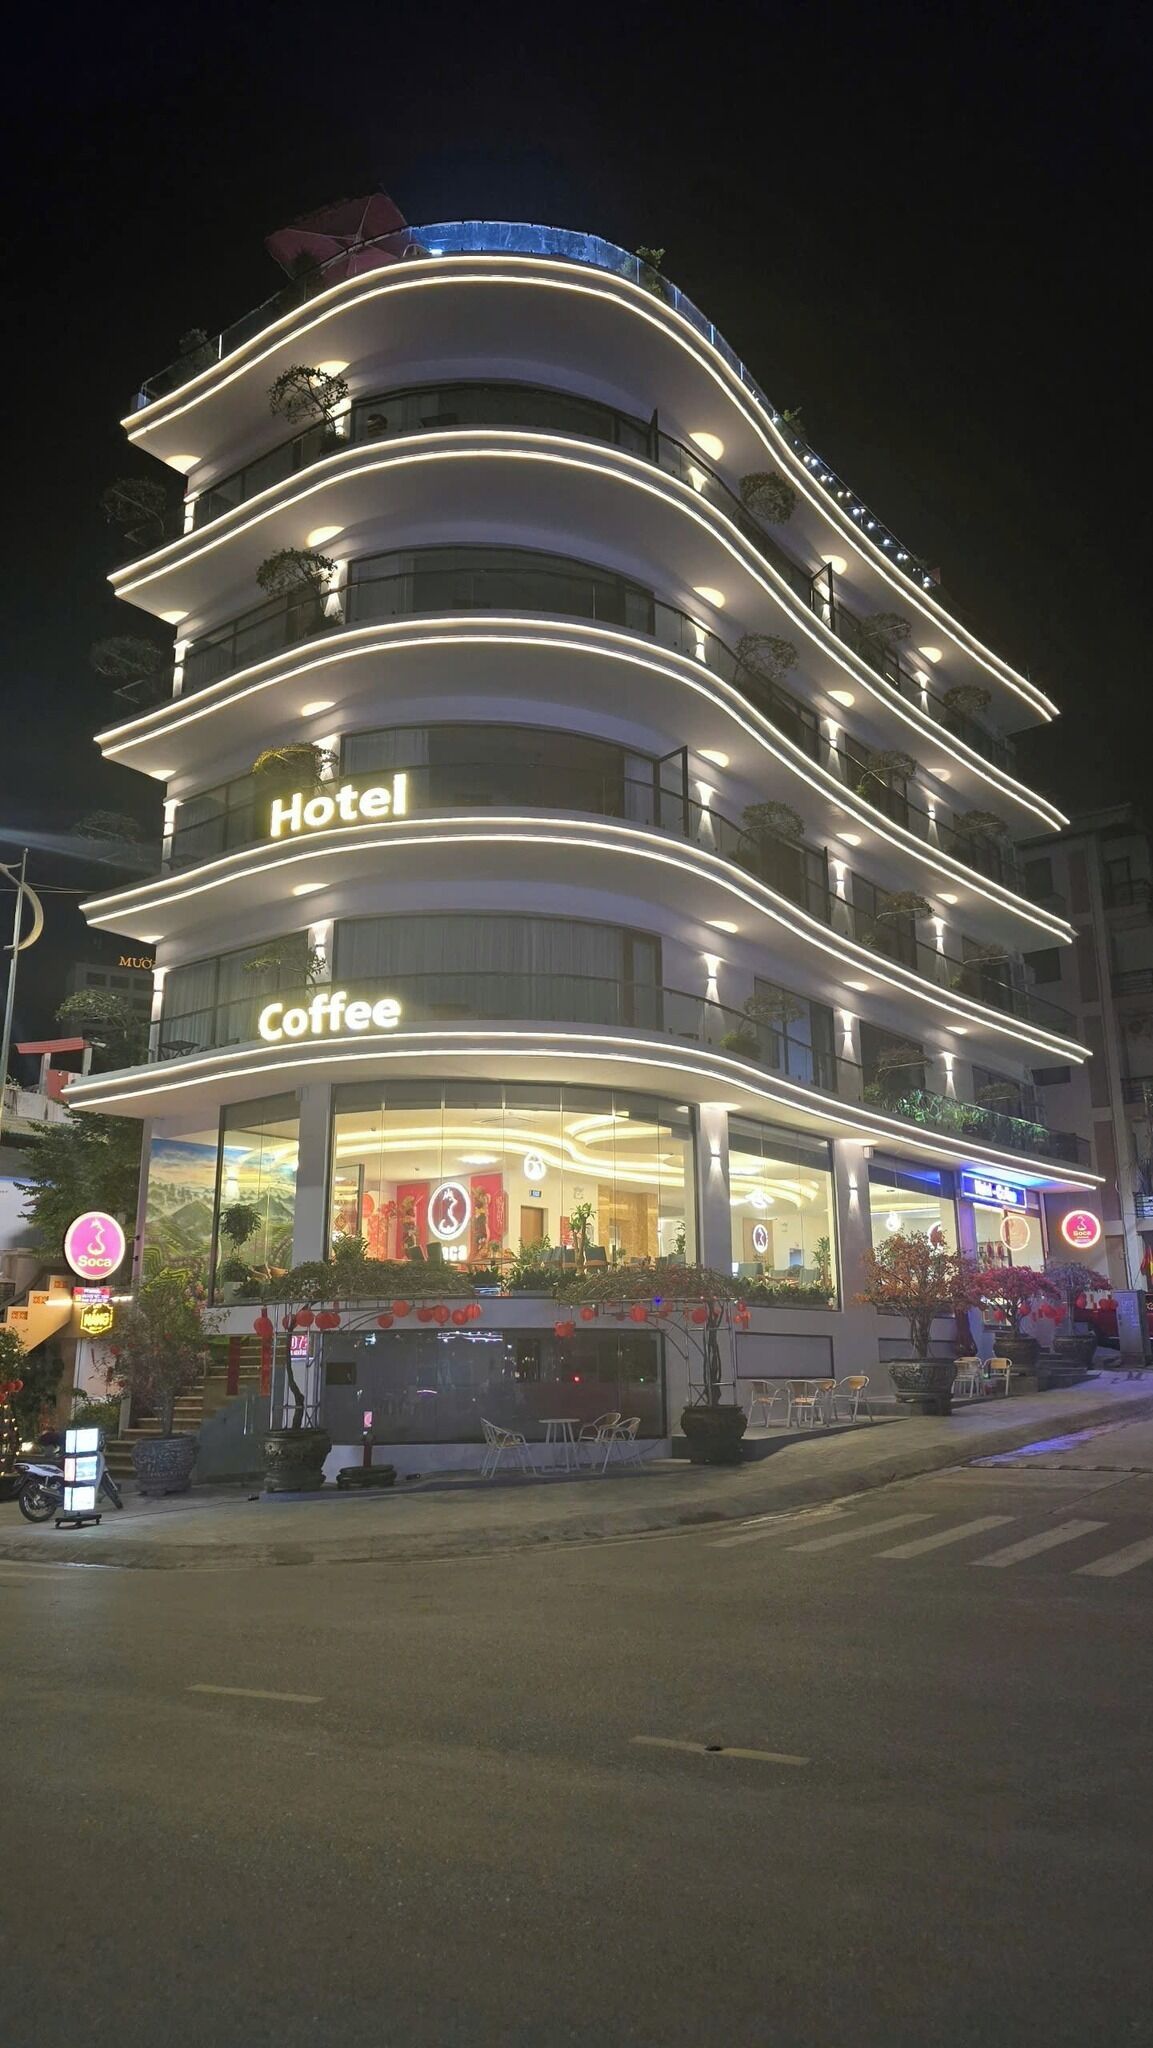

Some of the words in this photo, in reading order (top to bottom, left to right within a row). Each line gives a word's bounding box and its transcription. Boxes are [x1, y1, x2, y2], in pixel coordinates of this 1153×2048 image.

[269, 772, 409, 837] Hotel
[118, 956, 156, 969] MƯỜ
[258, 990, 402, 1042] Coffee
[78, 1255, 112, 1267] Soca
